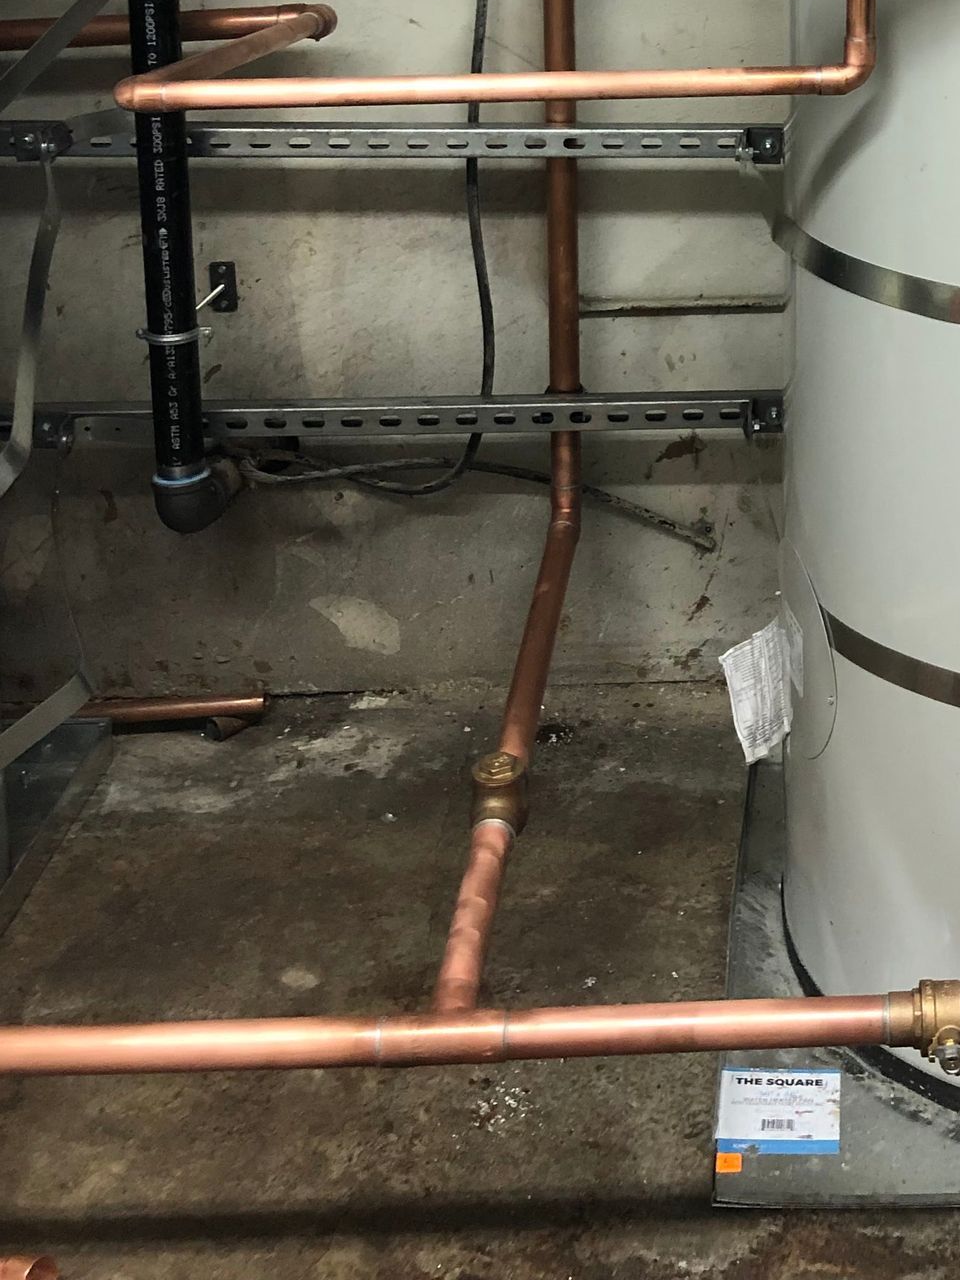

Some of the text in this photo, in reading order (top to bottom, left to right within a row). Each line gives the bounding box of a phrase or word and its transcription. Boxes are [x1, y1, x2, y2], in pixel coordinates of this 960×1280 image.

[144, 3, 156, 46] 1200PSI
[147, 52, 157, 65] TO
[151, 116, 163, 153] 300PSI
[153, 159, 165, 191] RATED
[168, 401, 179, 420] A53
[170, 425, 180, 449] ASTM
[735, 1077, 824, 1087] THE SQUARE
